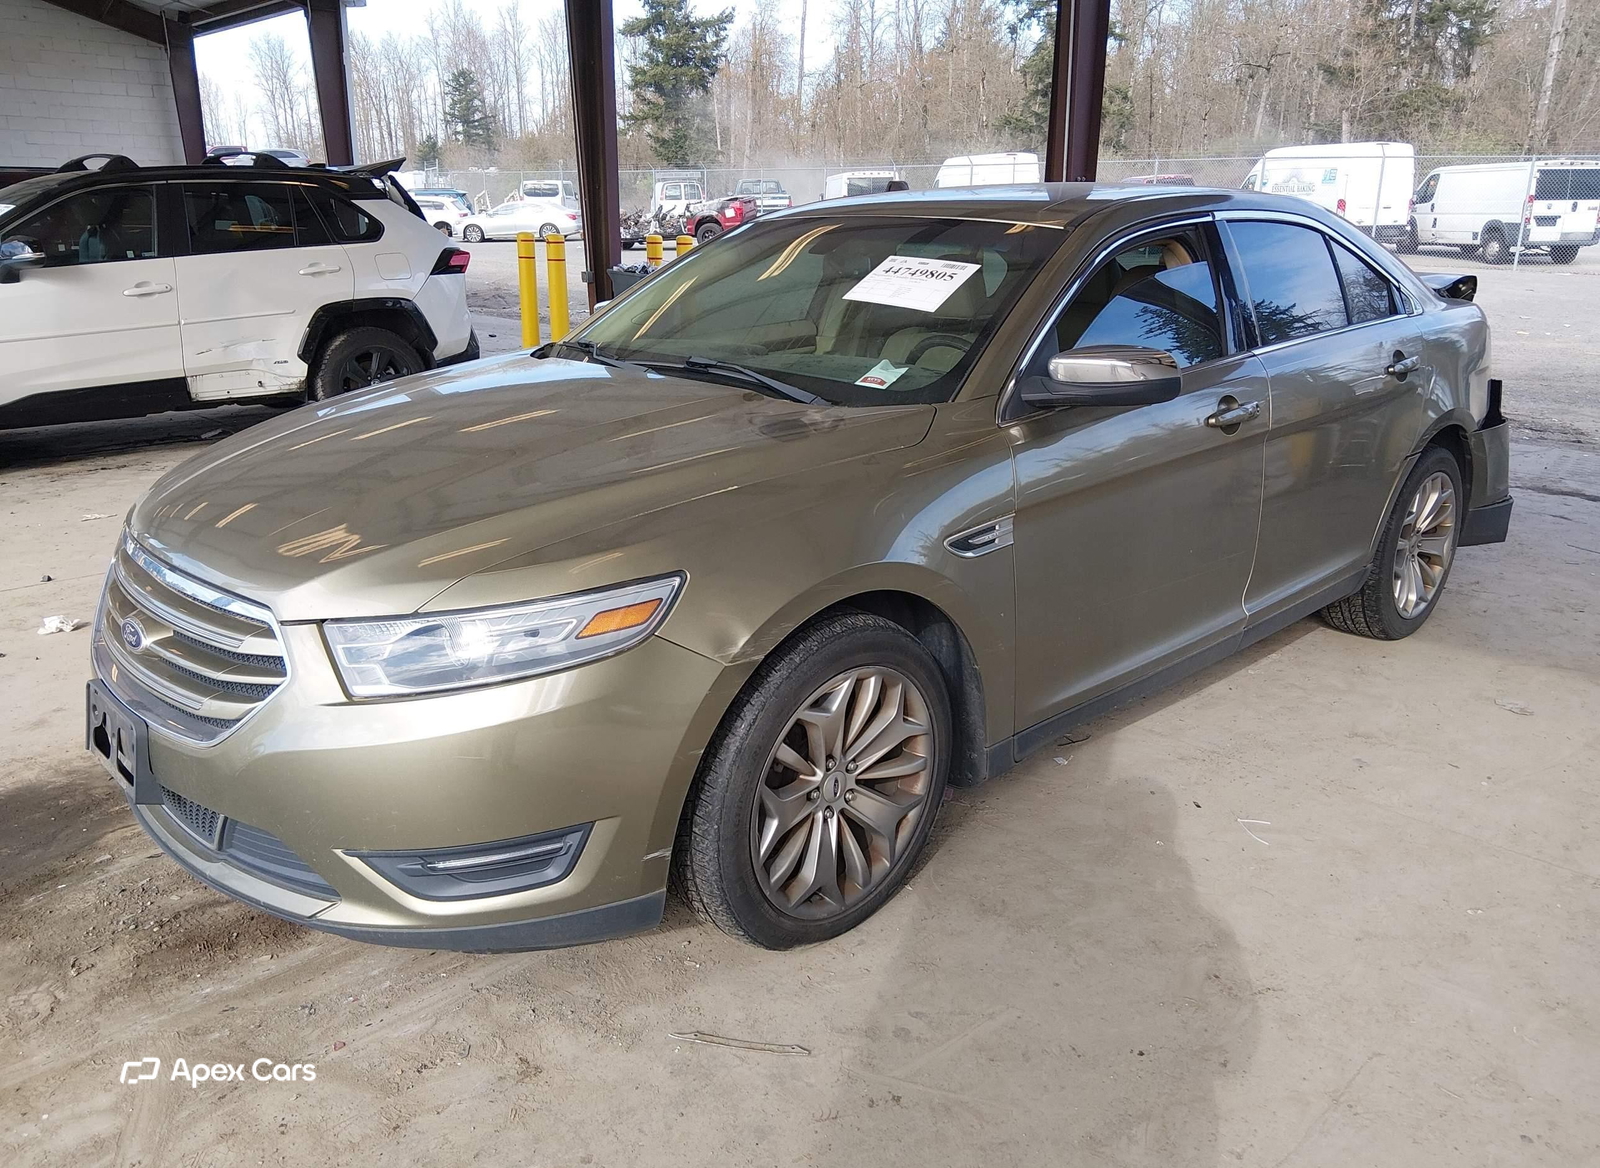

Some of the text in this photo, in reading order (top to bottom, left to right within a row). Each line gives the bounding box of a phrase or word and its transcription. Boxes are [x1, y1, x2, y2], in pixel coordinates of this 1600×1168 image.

[1271, 184, 1315, 193] ESSENTIAL BAKING
[882, 266, 958, 281] 44749805
[123, 623, 139, 647] Ford
